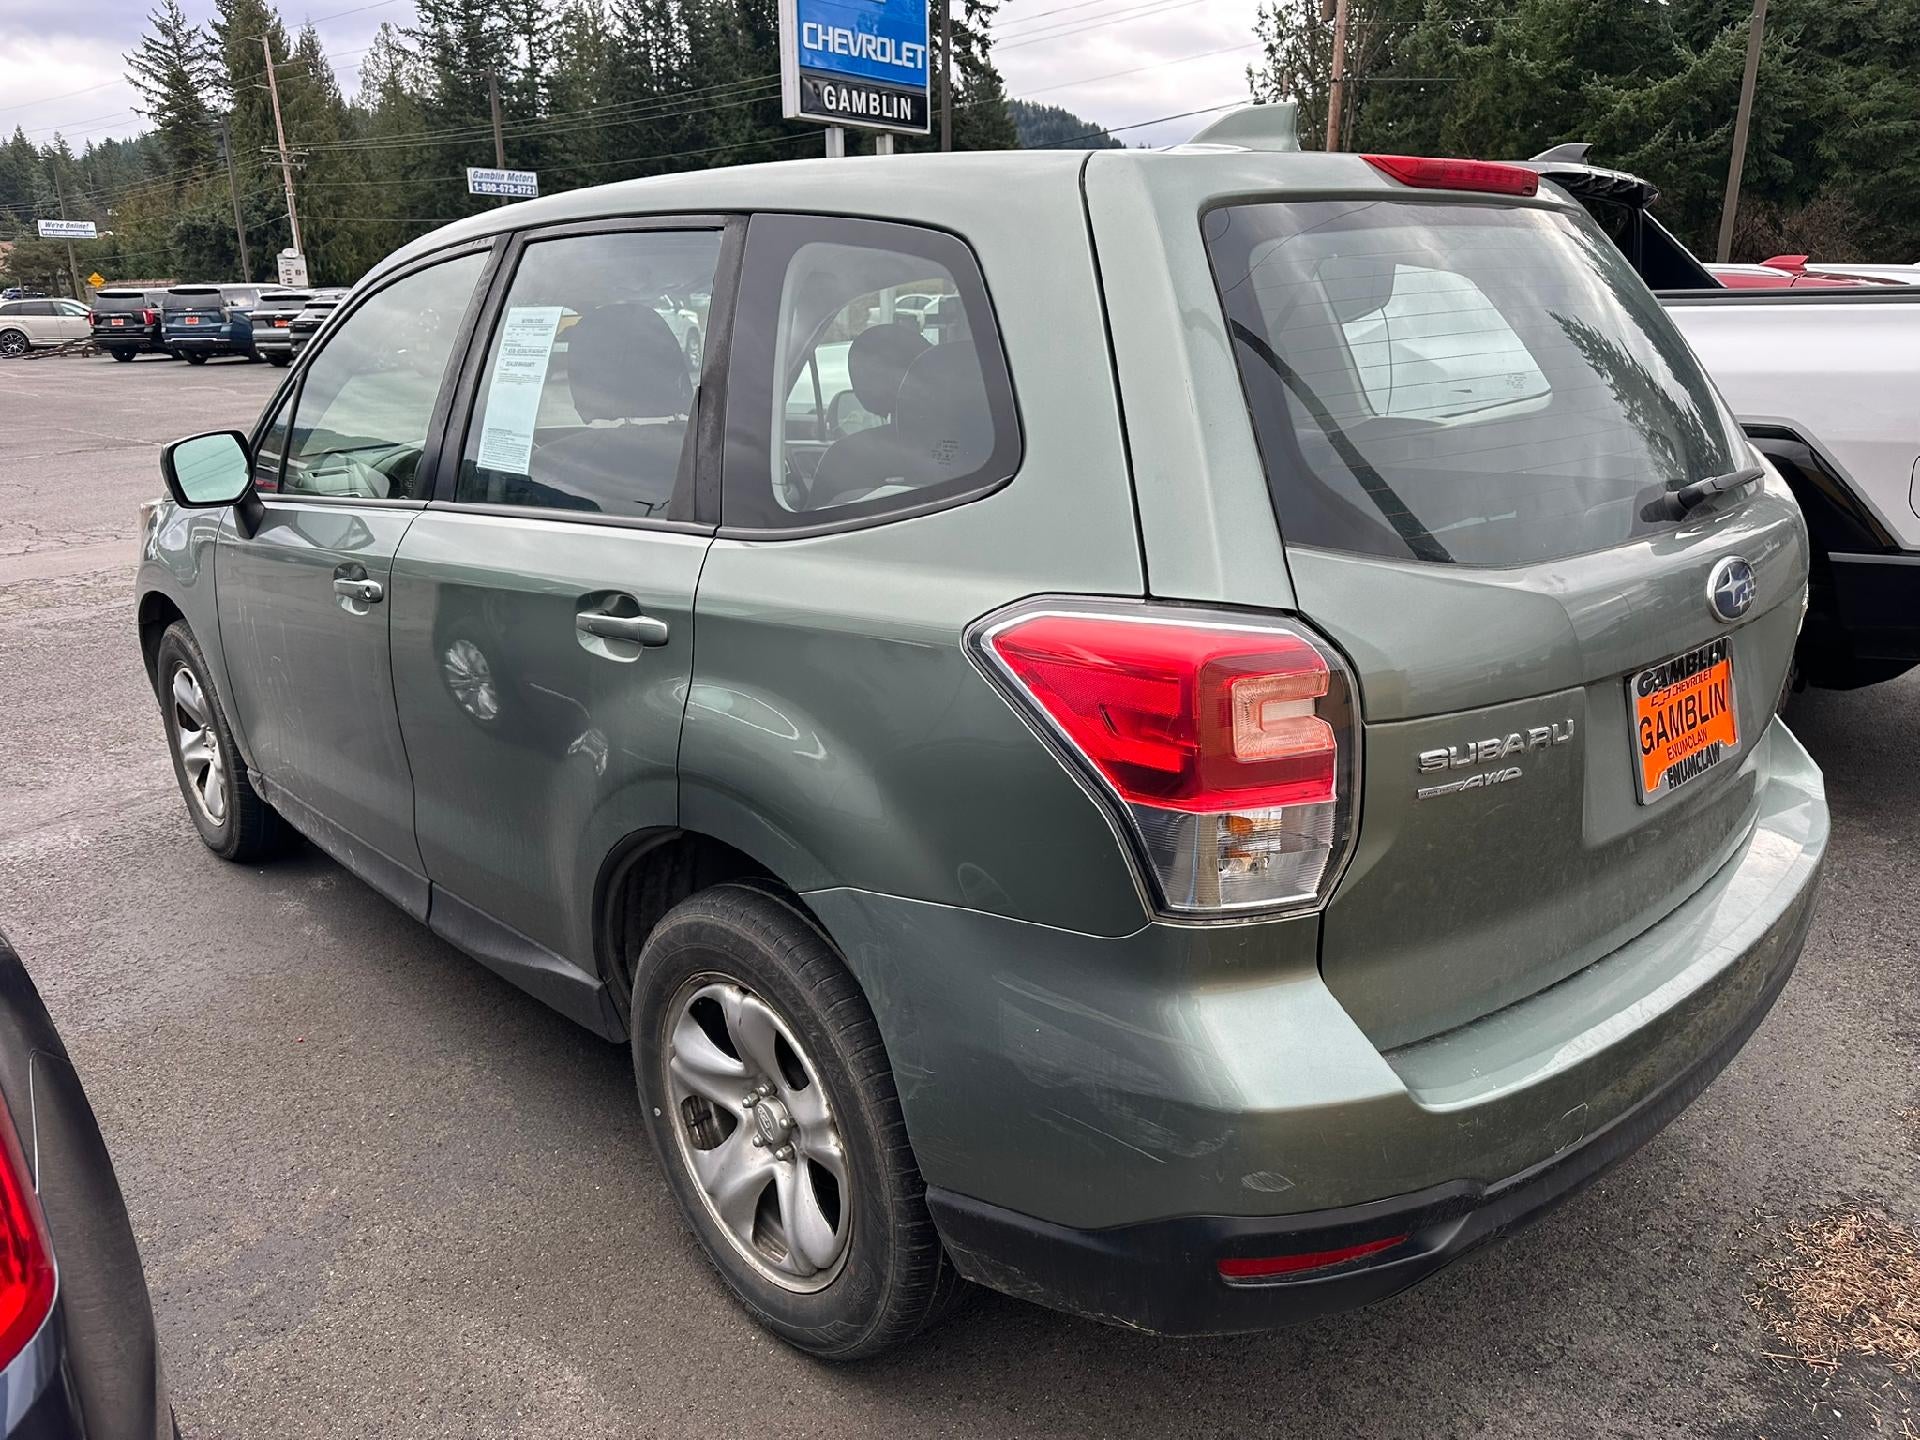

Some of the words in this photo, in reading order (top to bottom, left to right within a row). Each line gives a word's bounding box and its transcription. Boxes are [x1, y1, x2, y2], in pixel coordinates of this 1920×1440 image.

[802, 22, 926, 69] CHEVROLET
[823, 85, 912, 121] GAMBLIN
[472, 171, 505, 180] Gamblin
[507, 173, 534, 183] Motors
[1637, 637, 1728, 697] GAMBLIN
[1672, 667, 1713, 697] CHEVROLET
[1639, 678, 1727, 756] GAMBLIN
[1417, 719, 1575, 774] SUBARU
[1666, 727, 1708, 761] ENUMCLAW
[1457, 766, 1523, 792] AWD
[1666, 740, 1721, 790] ENUMCLAW
